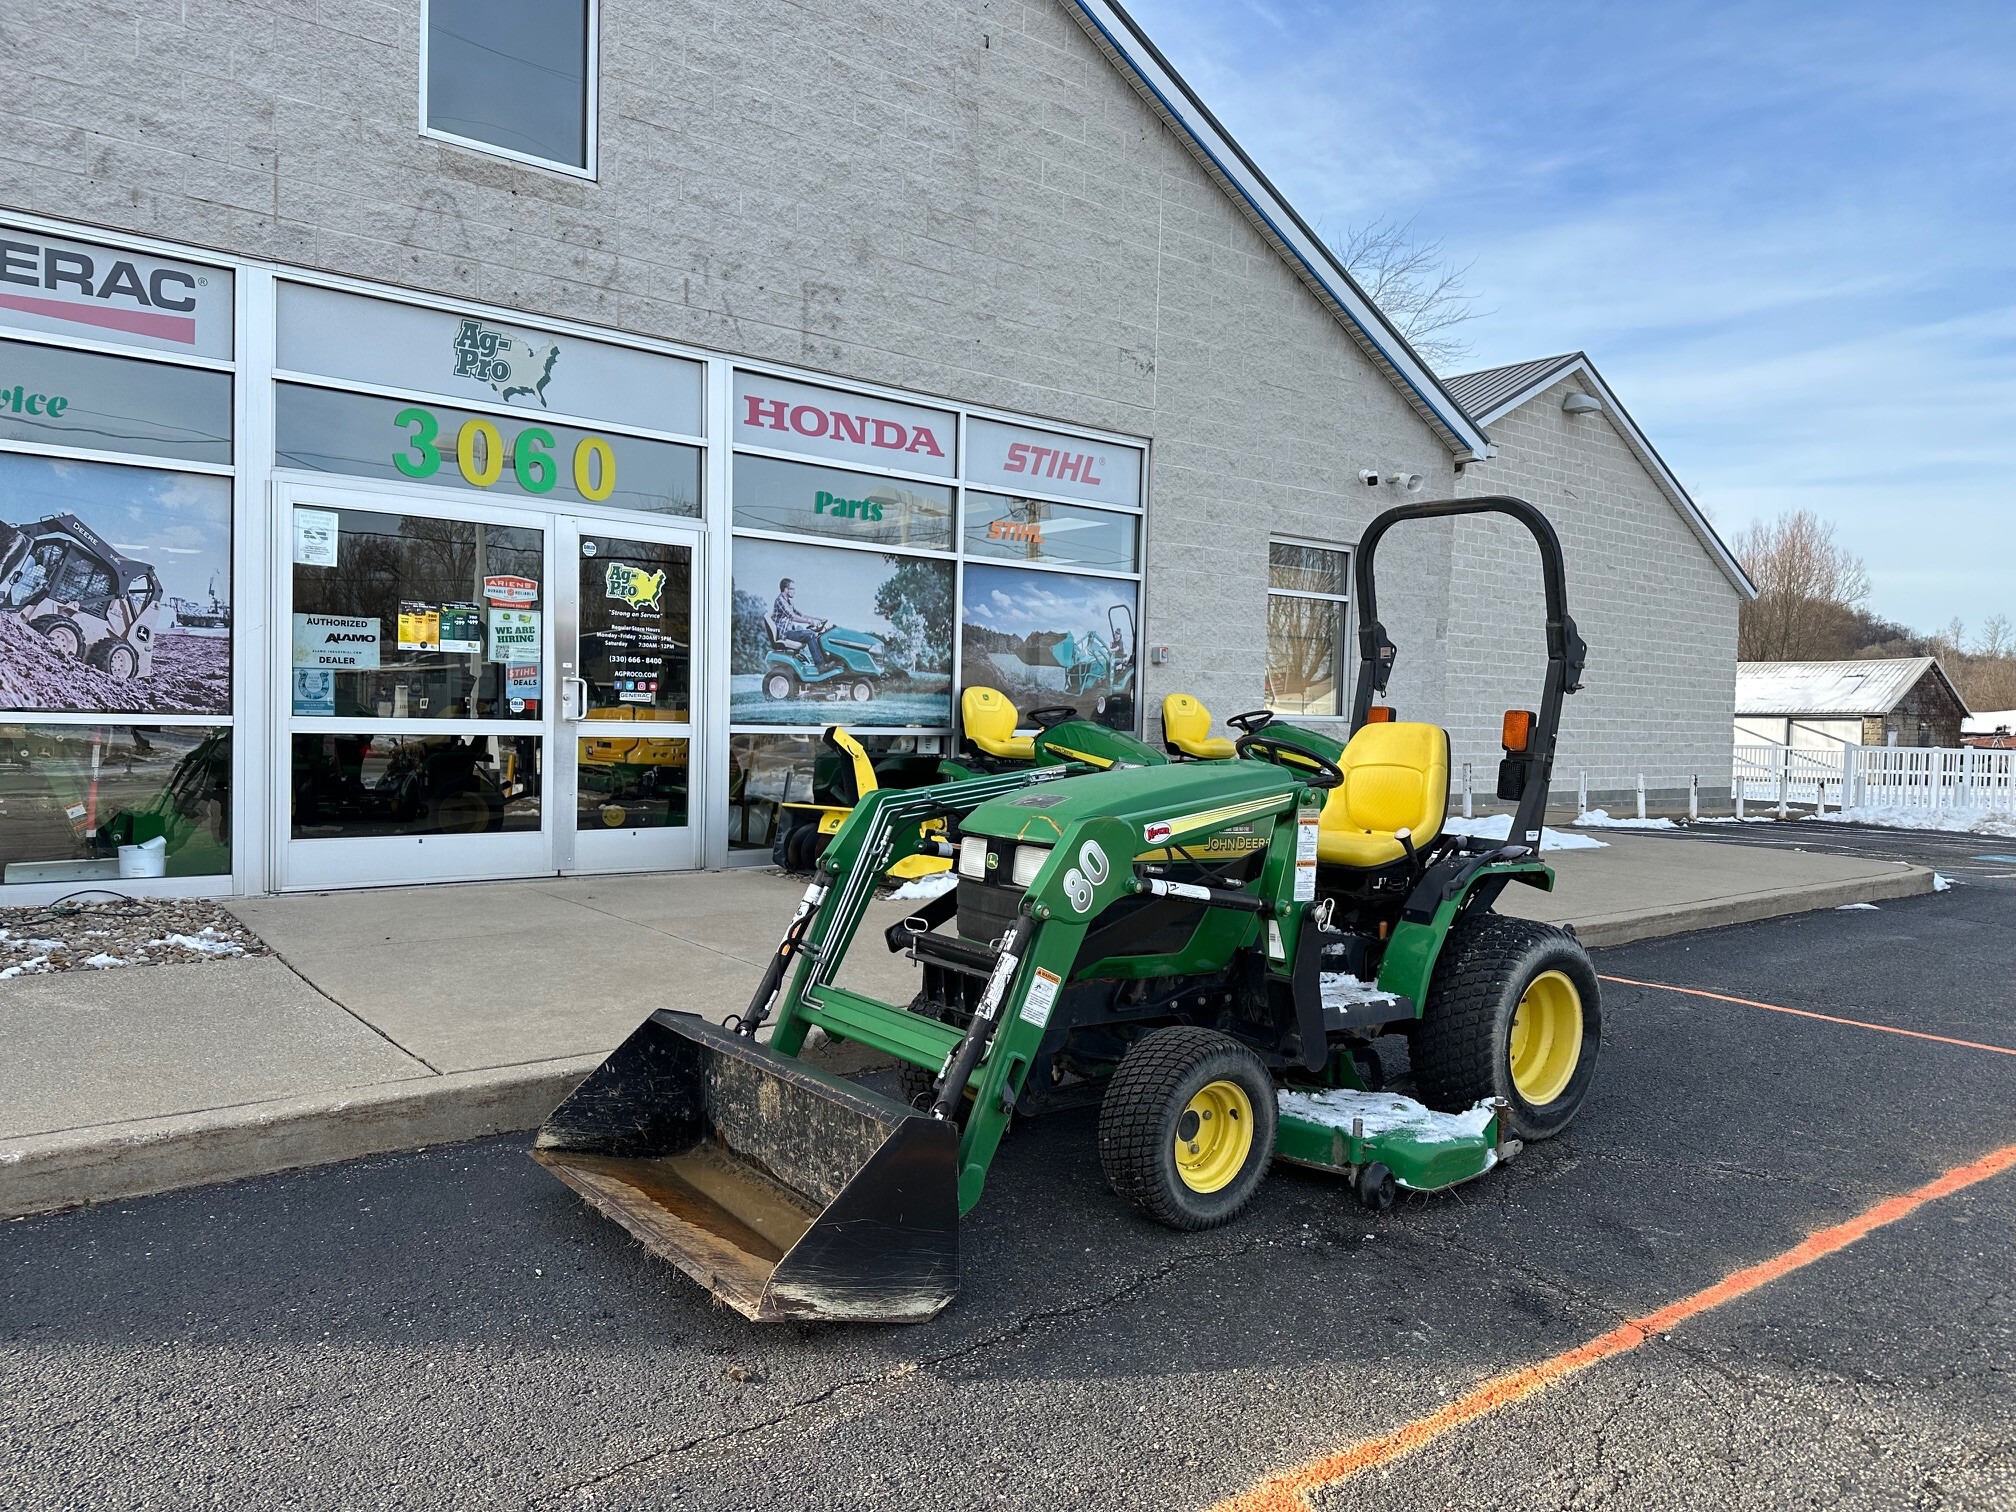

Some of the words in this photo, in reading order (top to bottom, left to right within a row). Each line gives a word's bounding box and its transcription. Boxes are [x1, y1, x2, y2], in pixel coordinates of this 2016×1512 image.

[453, 319, 512, 359] Ag-
[453, 347, 512, 382] Pro
[743, 394, 945, 458] HONDA
[392, 407, 616, 503] 3060
[1003, 442, 1102, 486] STIHL
[814, 490, 884, 522] Parts
[73, 521, 99, 546] DEERE
[986, 520, 1046, 544] STIHL
[609, 565, 638, 584] Ag-
[489, 579, 532, 589] ARIENS
[609, 580, 638, 597] Pro
[306, 617, 368, 628] AUTHORIZED
[494, 626, 513, 635] WE
[514, 626, 536, 635] ARE
[324, 632, 377, 644] ALAMO
[496, 634, 535, 643] HIRING
[596, 631, 618, 639] Monday
[620, 633, 637, 641] Friday
[604, 640, 628, 648] Saturday
[318, 656, 356, 665] DEALER
[609, 655, 627, 664] (330)
[627, 655, 641, 664] 666
[645, 657, 663, 665] 8400
[509, 667, 536, 678] STIHL
[614, 670, 658, 679] AGPROCO.COM
[1204, 836, 1236, 852] JOHN
[1063, 839, 1110, 914] 80
